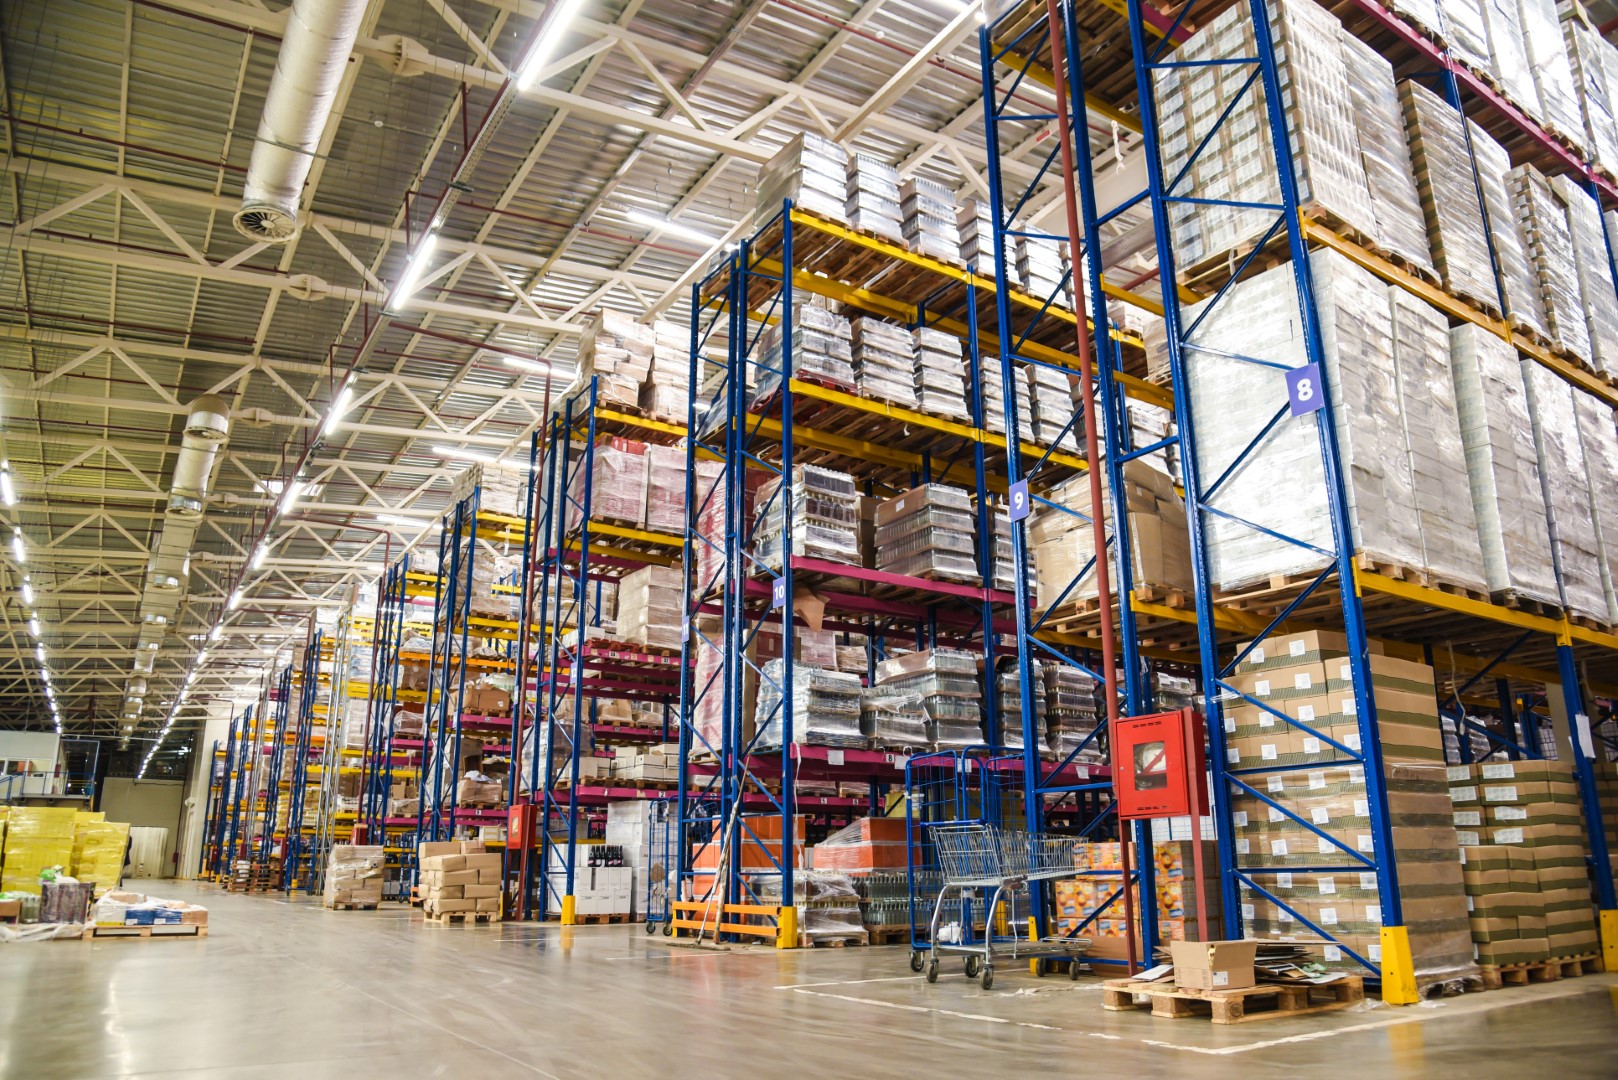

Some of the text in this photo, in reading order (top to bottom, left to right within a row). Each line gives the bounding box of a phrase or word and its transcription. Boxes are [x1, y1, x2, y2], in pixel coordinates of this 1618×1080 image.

[1297, 378, 1313, 401] 8
[1014, 491, 1024, 510] 9
[774, 585, 784, 600] 10
[683, 622, 689, 636] 11
